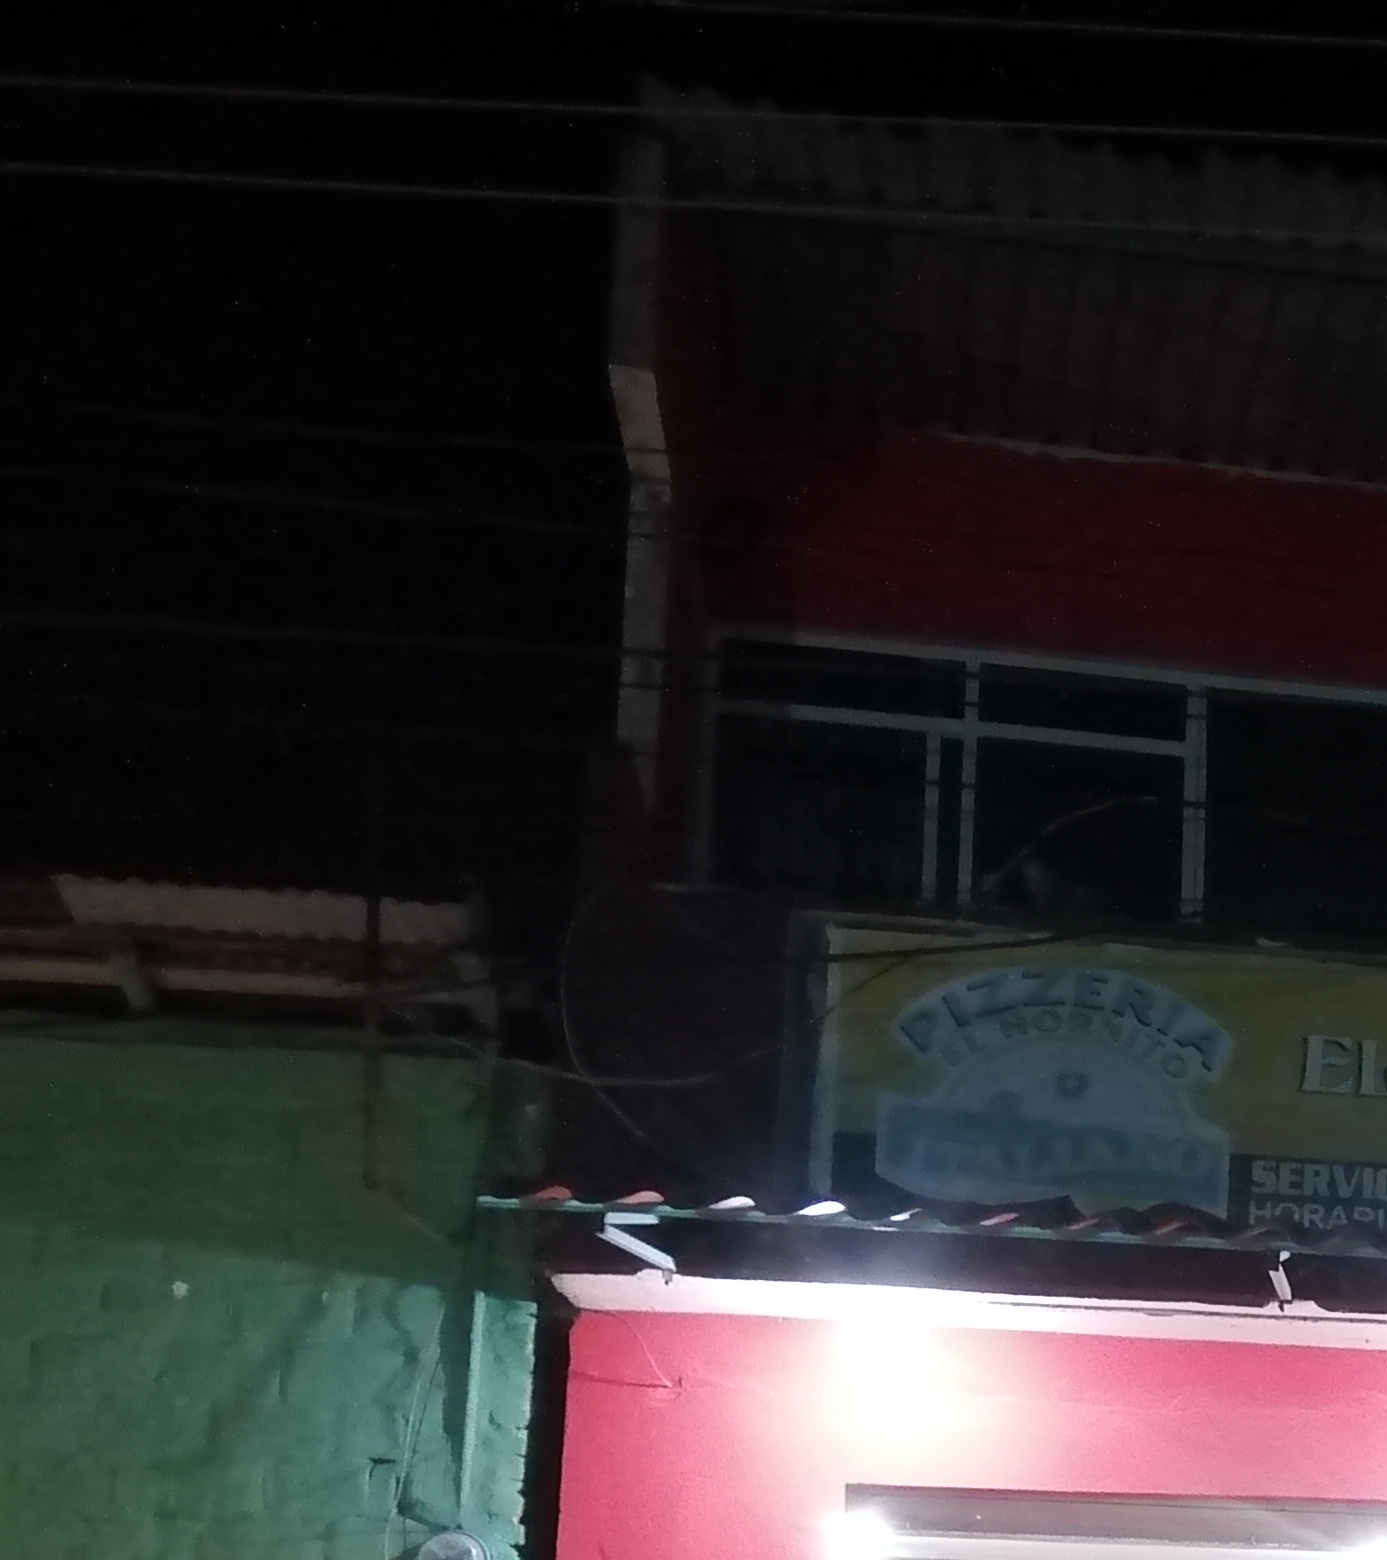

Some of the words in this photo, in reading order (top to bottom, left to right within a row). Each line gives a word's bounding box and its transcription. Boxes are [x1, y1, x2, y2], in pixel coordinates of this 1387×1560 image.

[898, 969, 1223, 1073] PIZZERIA
[939, 1028, 986, 1067] EL
[998, 1008, 1190, 1079] HORNITO
